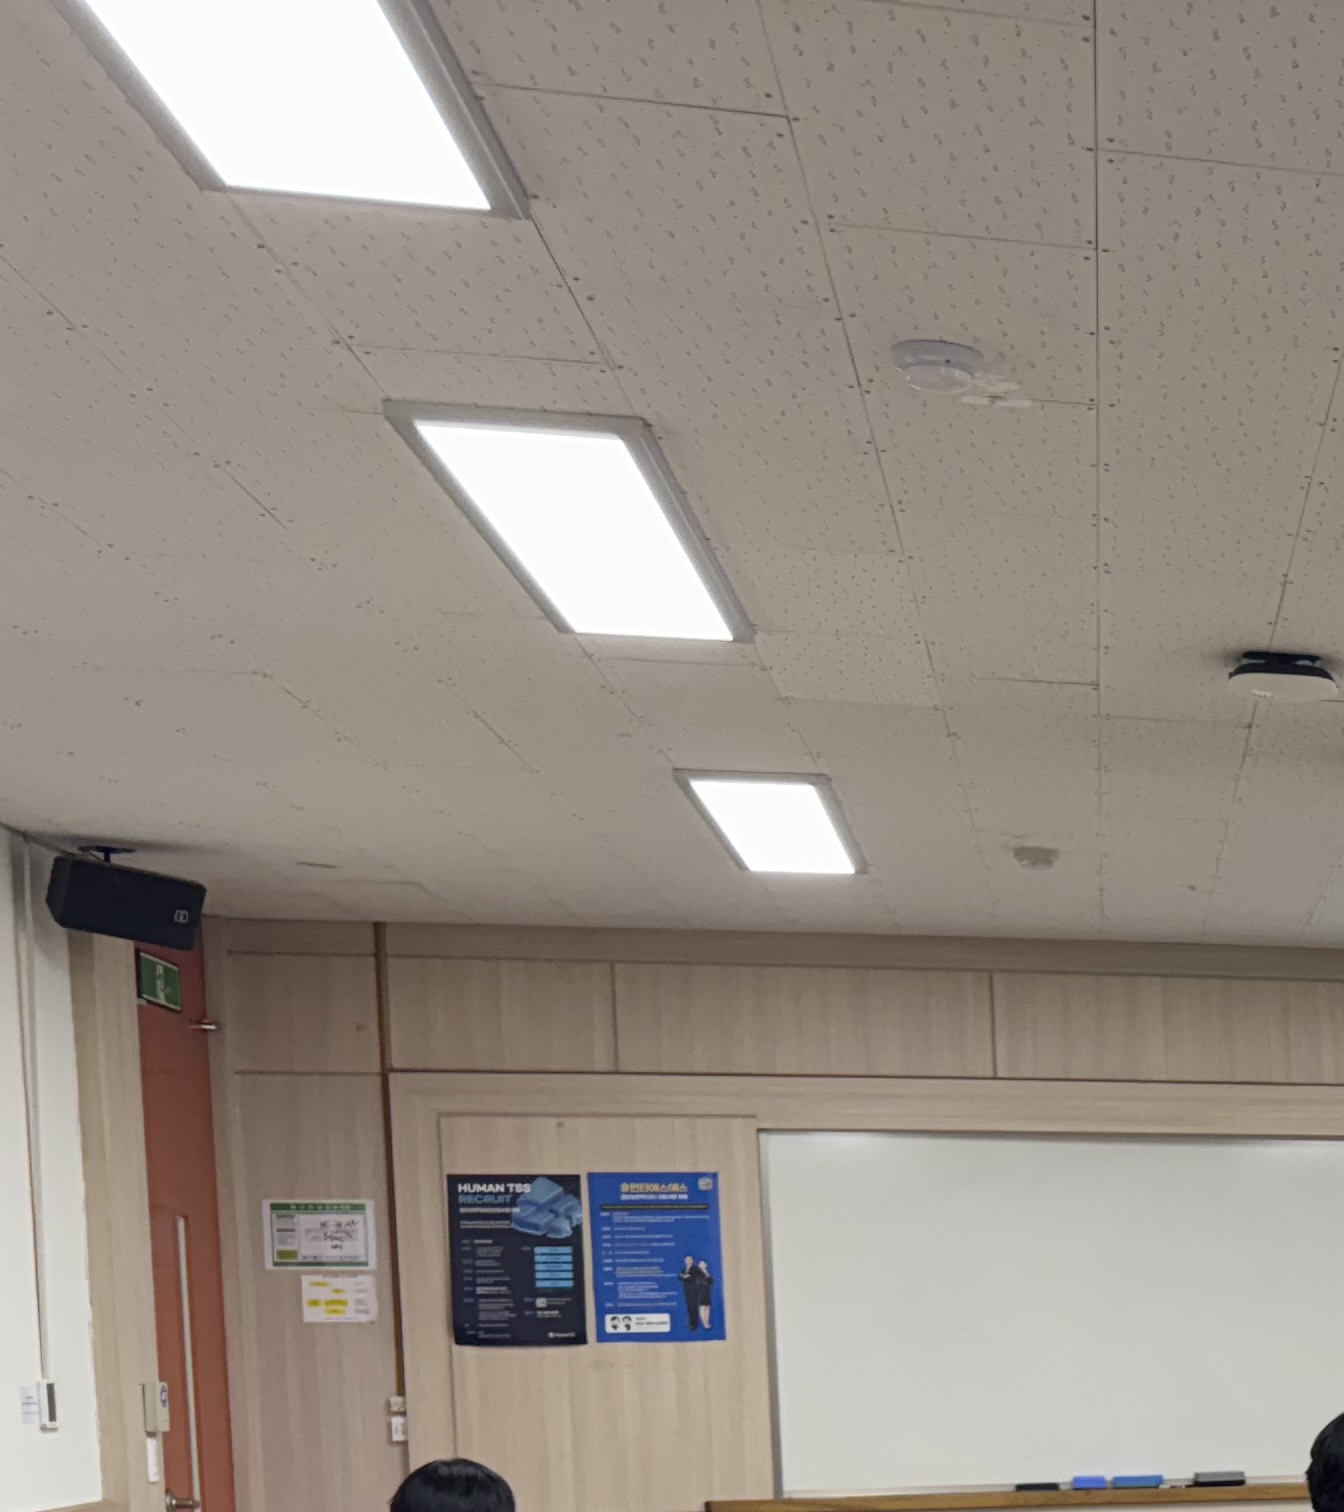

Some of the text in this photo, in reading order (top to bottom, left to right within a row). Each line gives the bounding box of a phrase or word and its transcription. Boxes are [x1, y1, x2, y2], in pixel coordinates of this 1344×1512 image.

[458, 1183, 531, 1193] HUMAN TSS
[458, 1194, 512, 1204] RECRUIT
